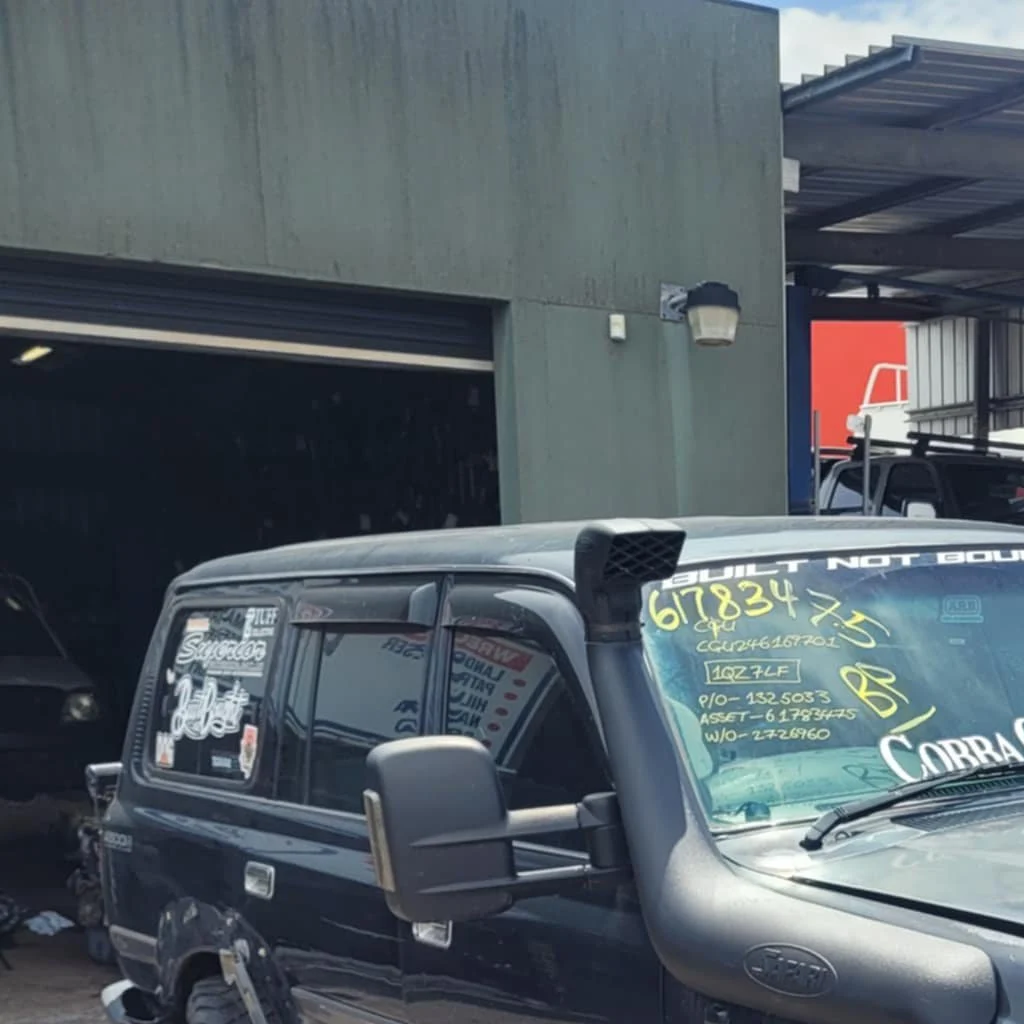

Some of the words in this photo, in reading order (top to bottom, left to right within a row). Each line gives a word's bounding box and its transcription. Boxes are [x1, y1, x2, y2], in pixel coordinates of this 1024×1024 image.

[661, 559, 809, 590] BUILT
[827, 553, 922, 570] NOT
[879, 732, 1024, 783] COBRA
